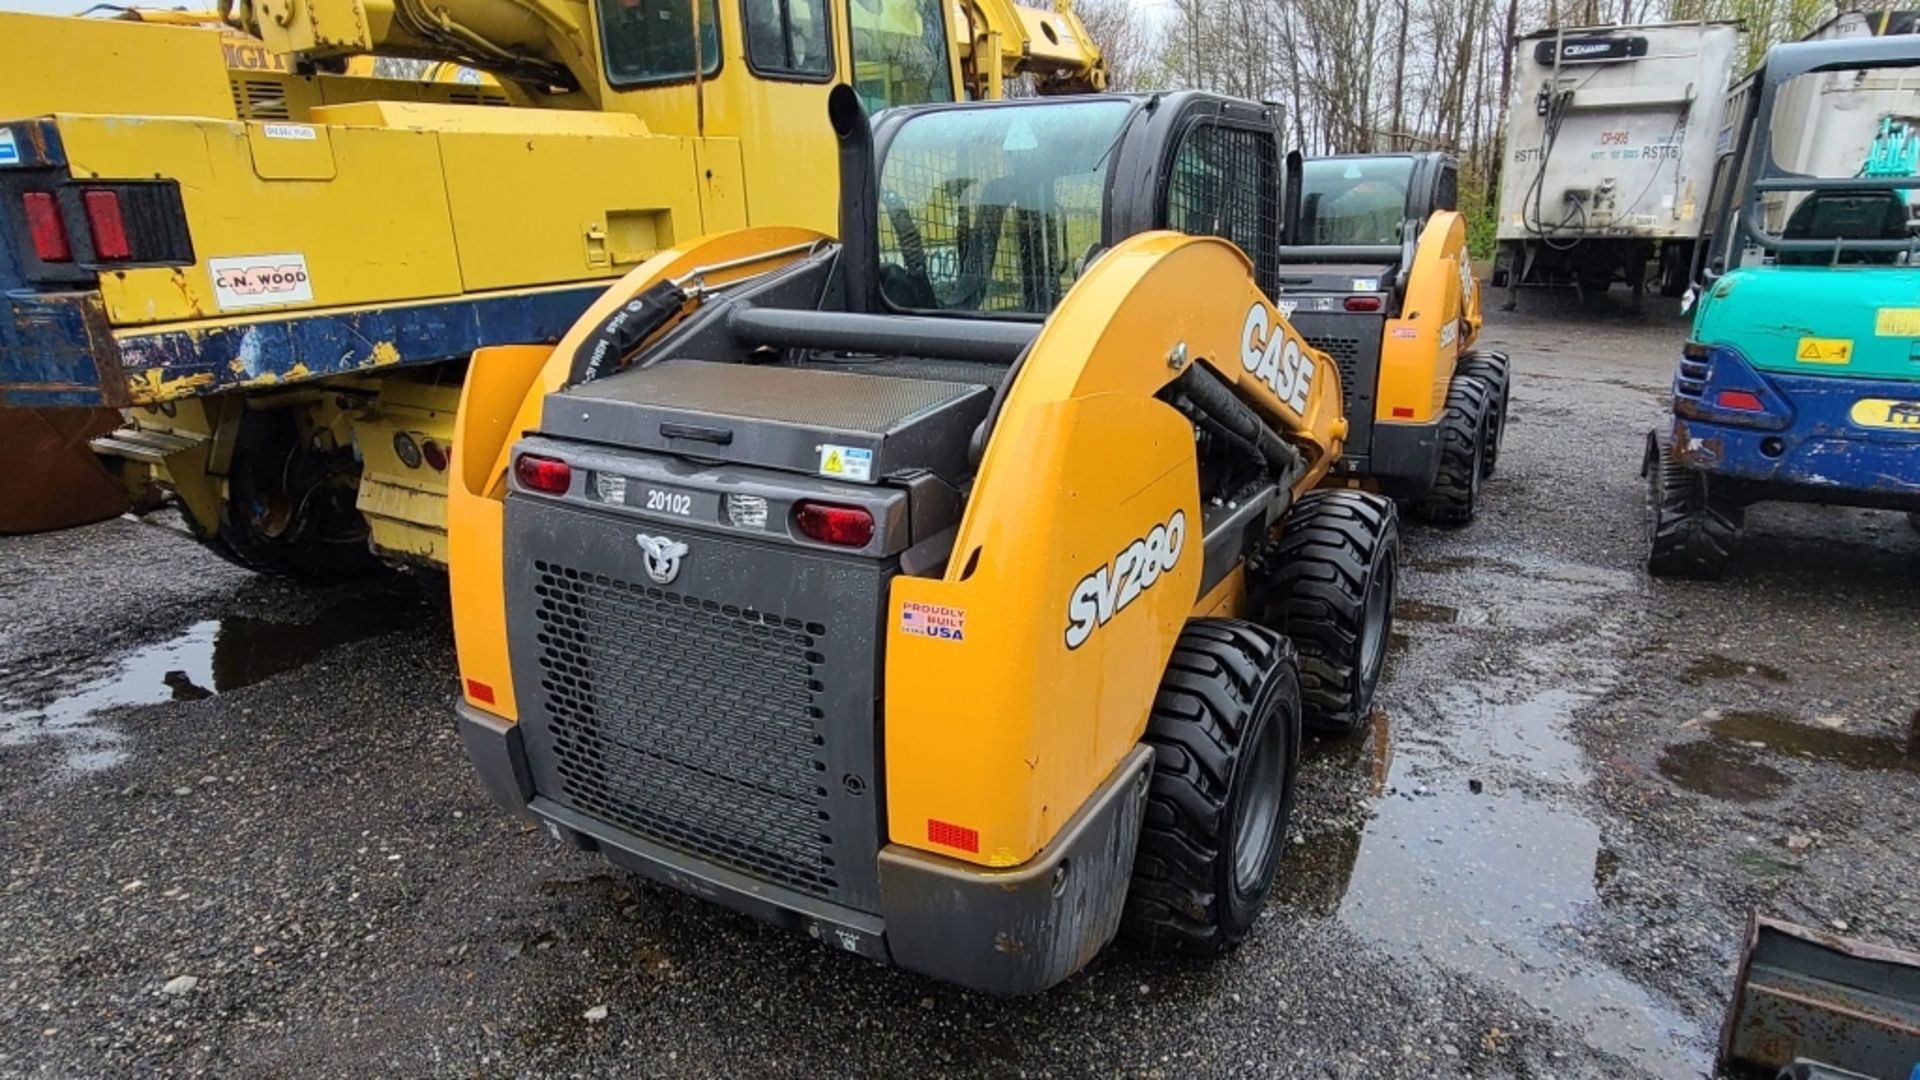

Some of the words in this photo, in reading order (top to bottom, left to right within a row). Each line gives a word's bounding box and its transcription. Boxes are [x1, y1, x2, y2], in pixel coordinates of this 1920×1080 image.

[1642, 145, 1678, 159] RSTT6
[216, 275, 253, 288] C.N.
[257, 271, 307, 286] WOOD
[1241, 301, 1317, 417] CASE
[646, 489, 691, 515] 20102
[1065, 508, 1186, 651] SV280
[903, 602, 965, 617] PROUDLY
[927, 615, 965, 627] BUILT
[927, 625, 963, 640] USA
